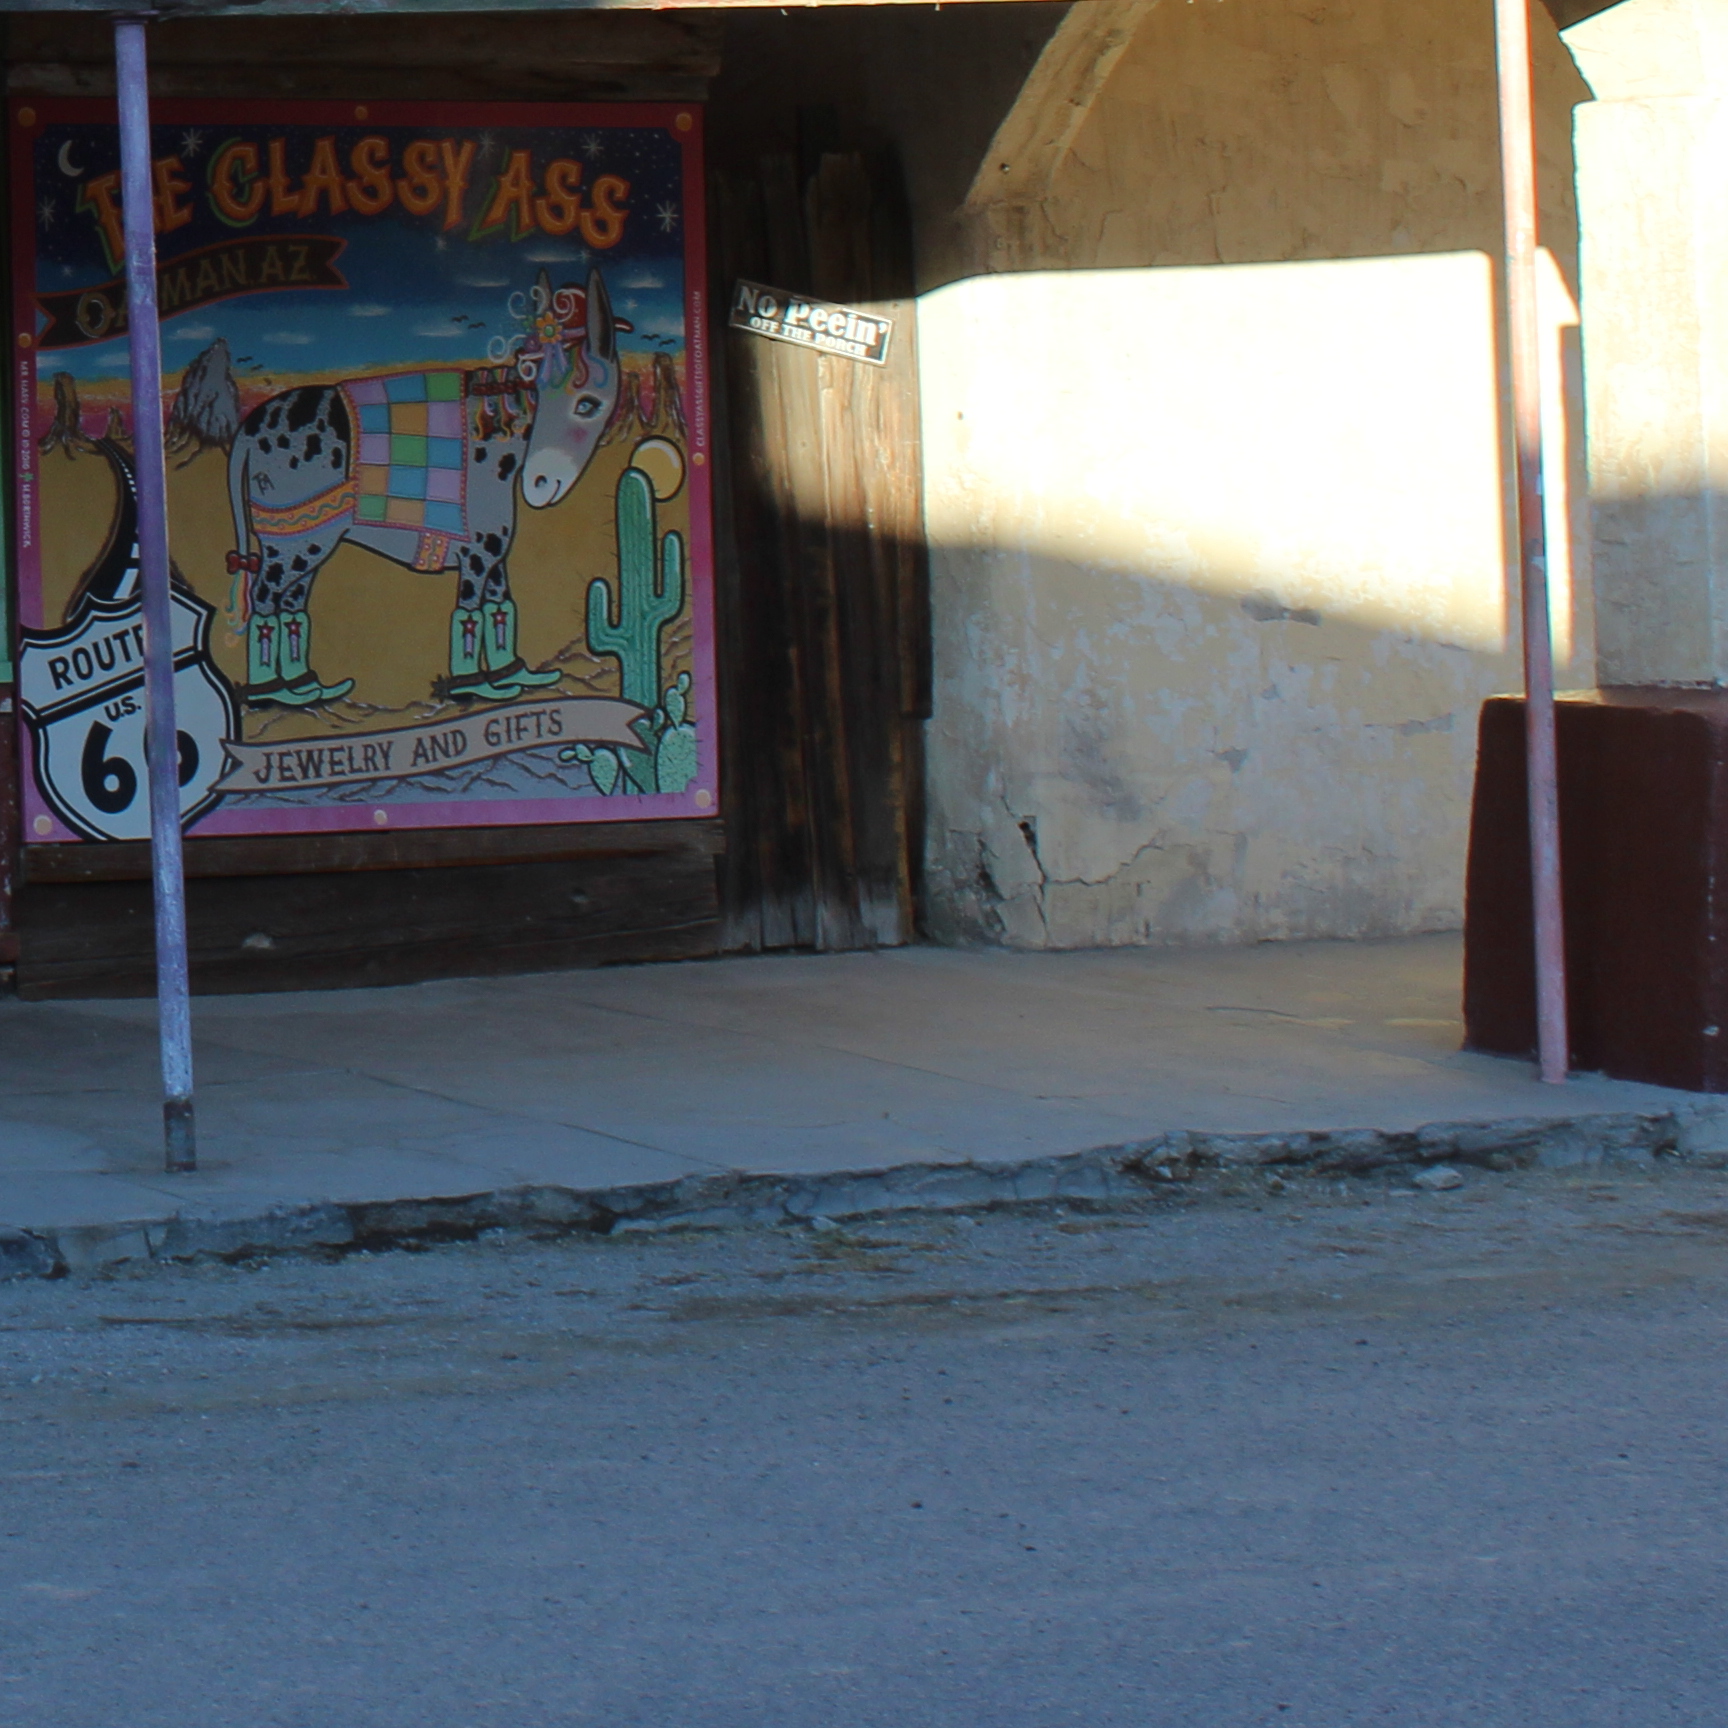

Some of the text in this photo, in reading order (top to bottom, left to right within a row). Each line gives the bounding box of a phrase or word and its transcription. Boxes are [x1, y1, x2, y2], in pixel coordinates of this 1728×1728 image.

[80, 135, 631, 267] TE CLASSY ASS
[750, 316, 869, 356] OFF THE PORCH
[253, 709, 565, 784] JEWELRY AND GIFTS
